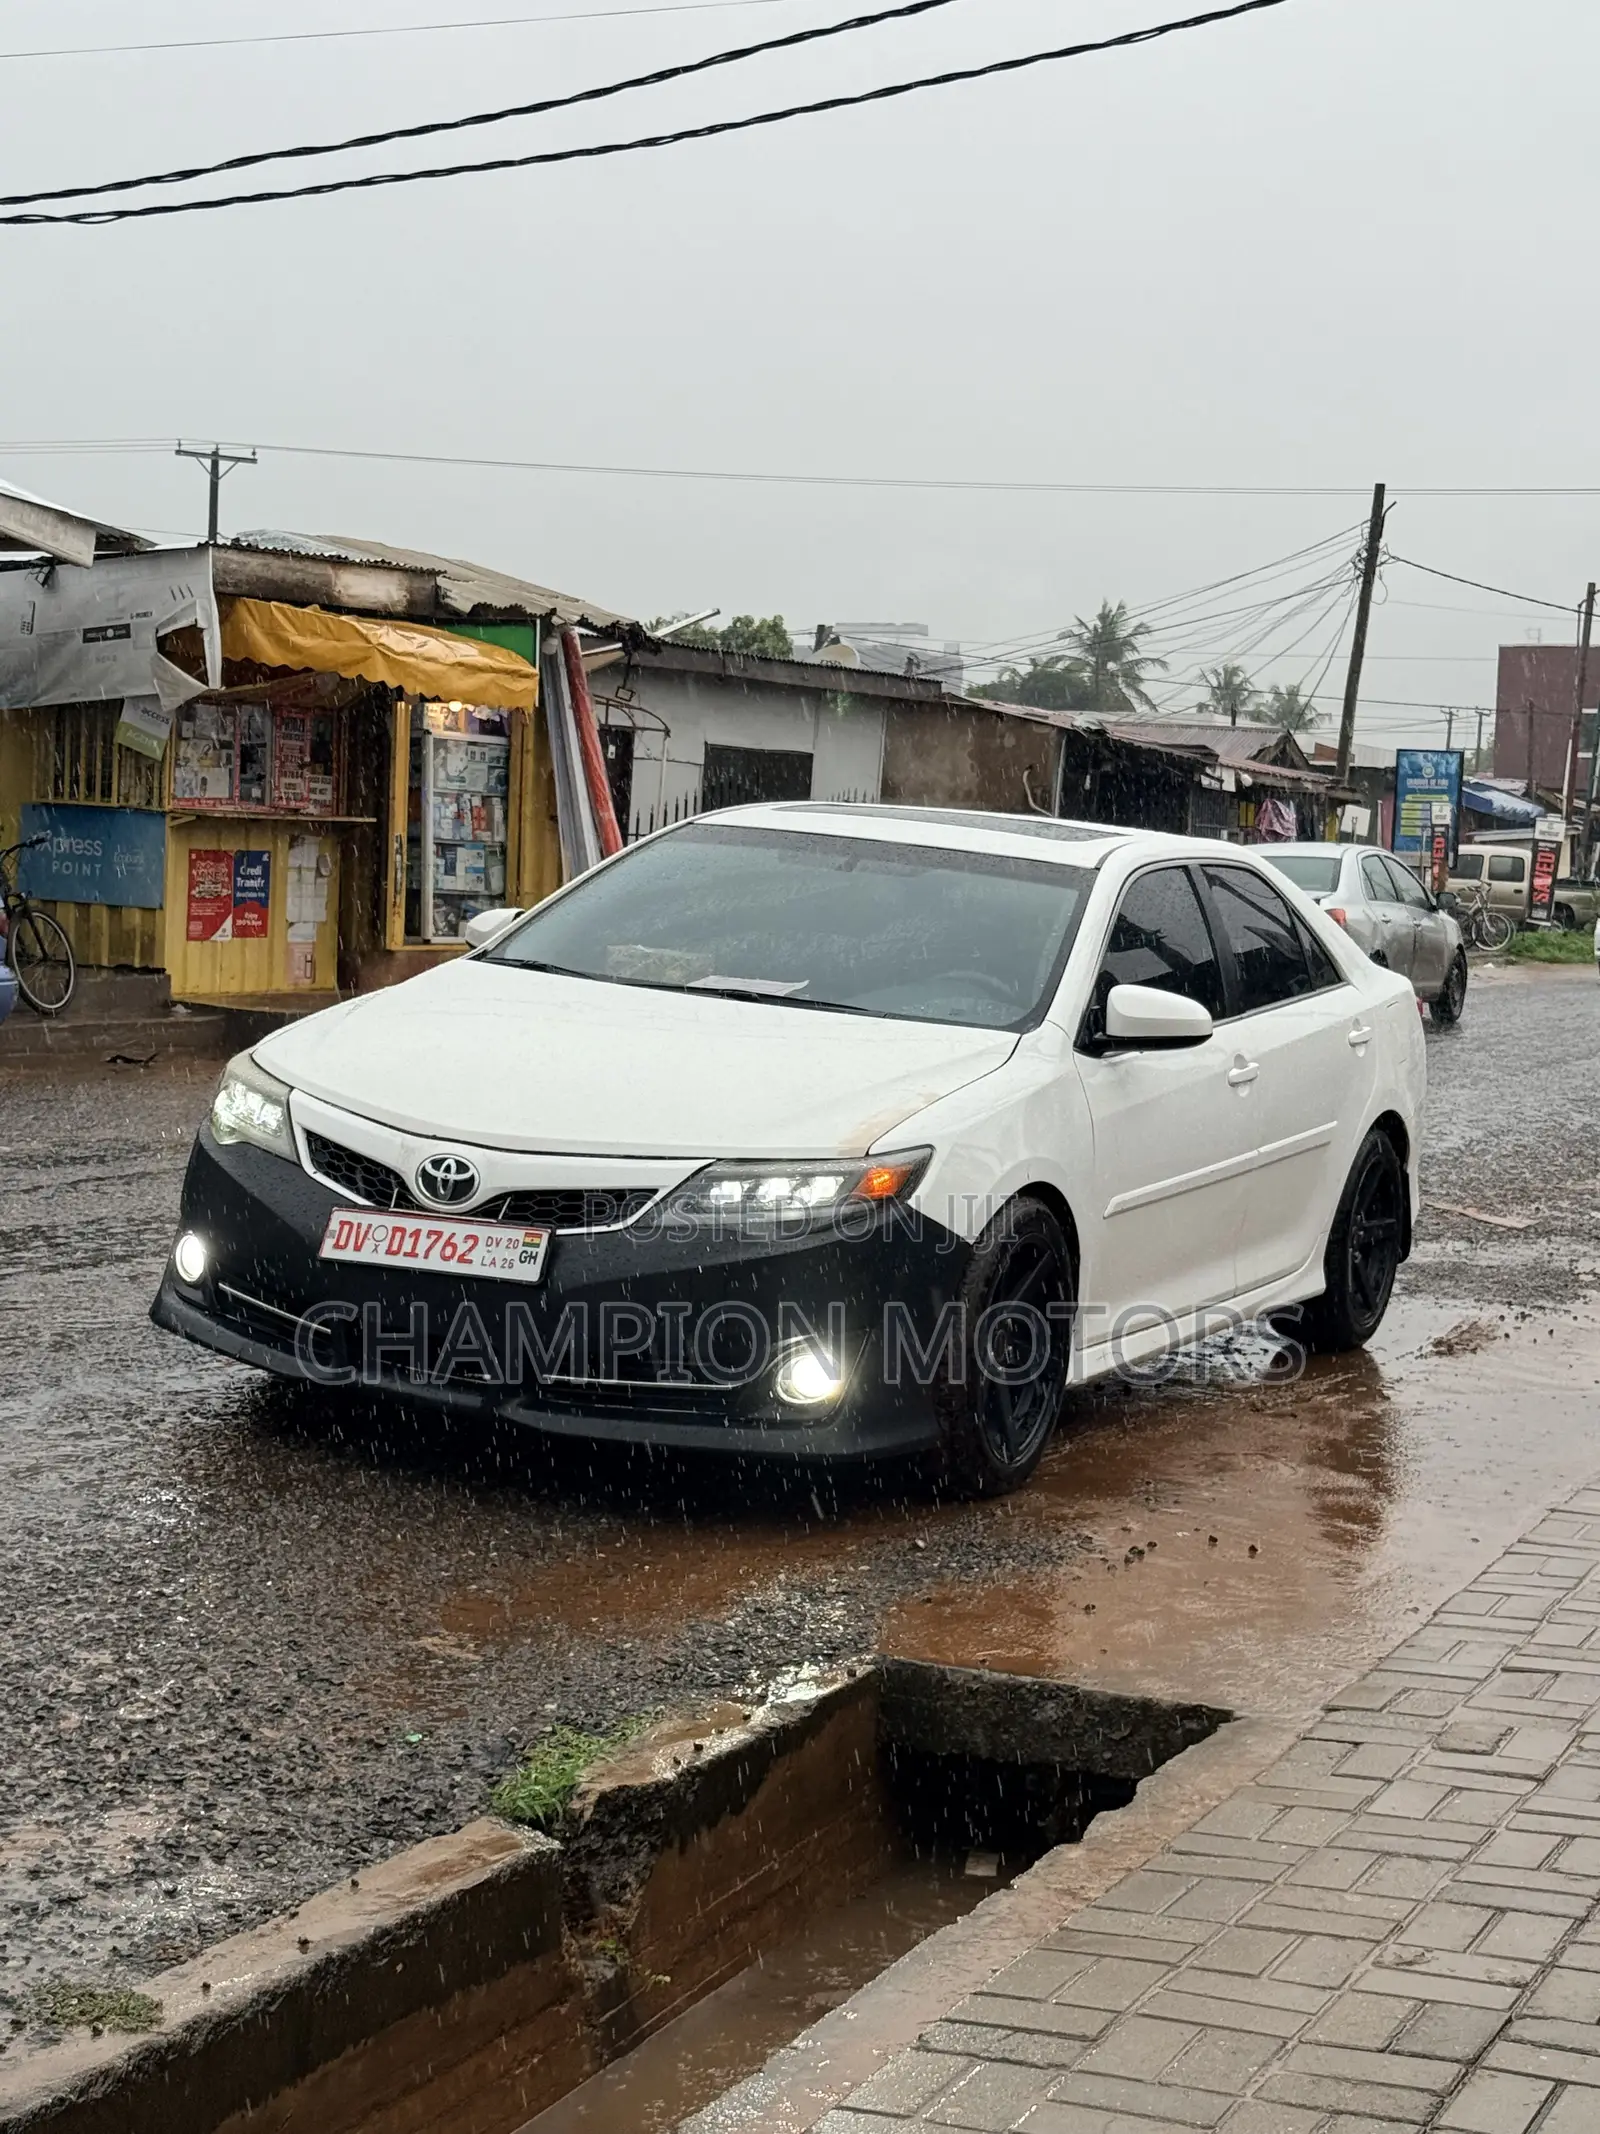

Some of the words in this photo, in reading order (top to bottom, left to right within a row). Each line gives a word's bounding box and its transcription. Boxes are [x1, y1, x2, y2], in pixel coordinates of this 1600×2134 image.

[52, 860, 102, 876] POINT
[332, 1220, 373, 1252] DV
[385, 1226, 480, 1264] D1762
[485, 1235, 503, 1248] DV
[505, 1237, 520, 1250] 20
[480, 1255, 497, 1268] LA
[500, 1257, 516, 1269] 26
[519, 1250, 539, 1266] GH
